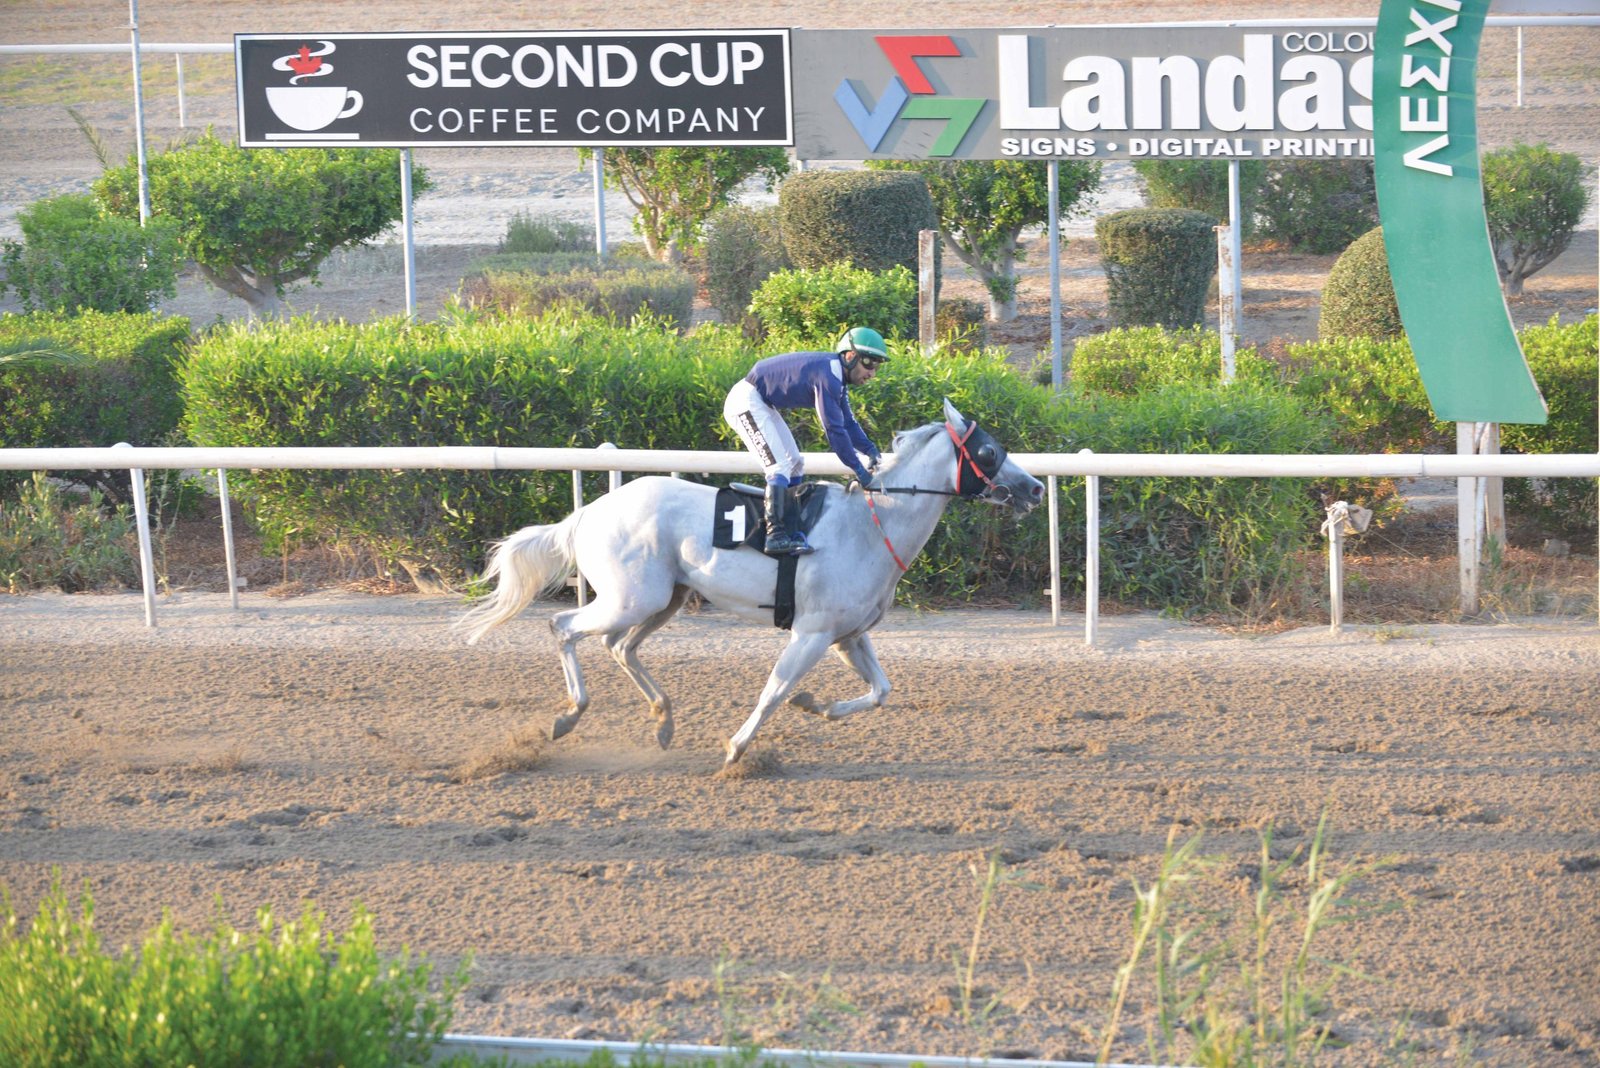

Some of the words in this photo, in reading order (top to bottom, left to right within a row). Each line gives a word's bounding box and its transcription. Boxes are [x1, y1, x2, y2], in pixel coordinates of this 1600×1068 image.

[406, 44, 638, 89] SECOND
[649, 41, 765, 87] CUP
[1399, 0, 1462, 177] ΛΕΣΧ
[408, 107, 559, 134] COFFEE
[576, 106, 766, 135] COMPANY
[1000, 137, 1097, 157] SIGNS
[1128, 137, 1253, 157] DIGITAL
[1261, 137, 1375, 157] PRINTI
[724, 504, 746, 542] 1
